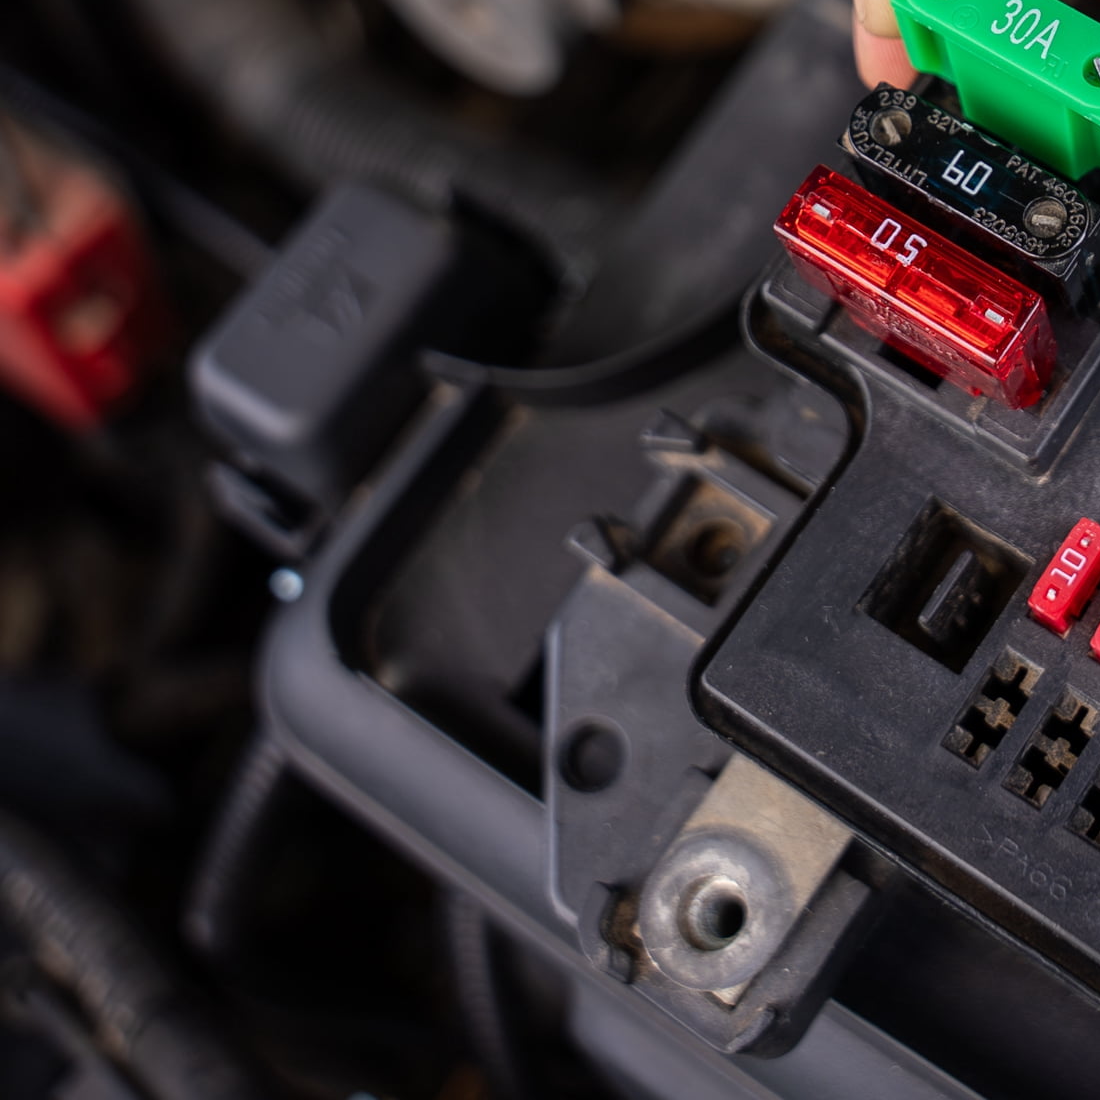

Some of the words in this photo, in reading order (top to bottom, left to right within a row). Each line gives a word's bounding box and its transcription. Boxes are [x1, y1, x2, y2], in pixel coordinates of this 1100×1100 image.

[941, 149, 993, 195] 60
[1006, 154, 1042, 184] PAT.
[870, 218, 928, 266] 50
[1051, 548, 1087, 586] 10
